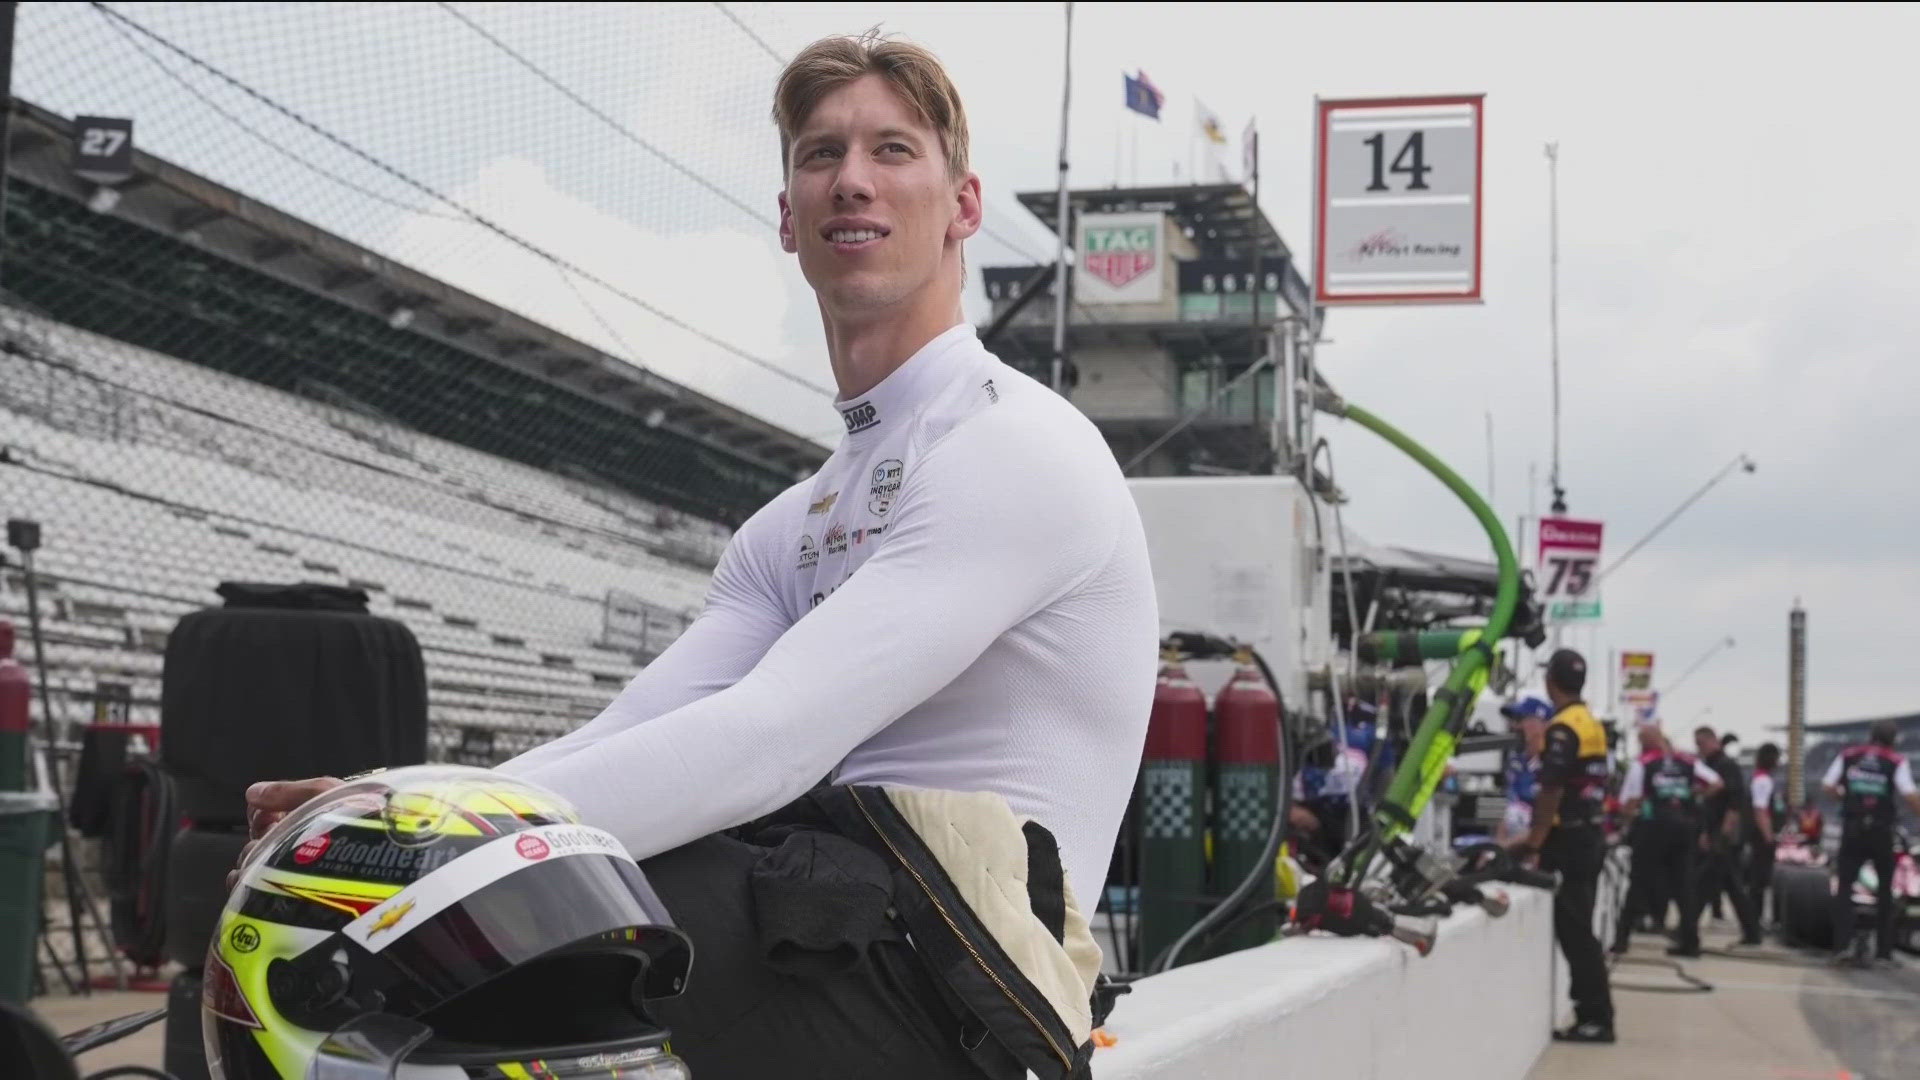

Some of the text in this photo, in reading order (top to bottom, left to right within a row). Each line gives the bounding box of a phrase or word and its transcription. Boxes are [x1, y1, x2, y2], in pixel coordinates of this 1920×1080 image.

[80, 127, 128, 158] 27
[1363, 130, 1432, 191] 14
[1093, 226, 1151, 252] TAG
[844, 405, 876, 430] OMP
[870, 481, 901, 495] INDYCAR
[1546, 558, 1596, 596] 75
[236, 925, 256, 945] Arai
